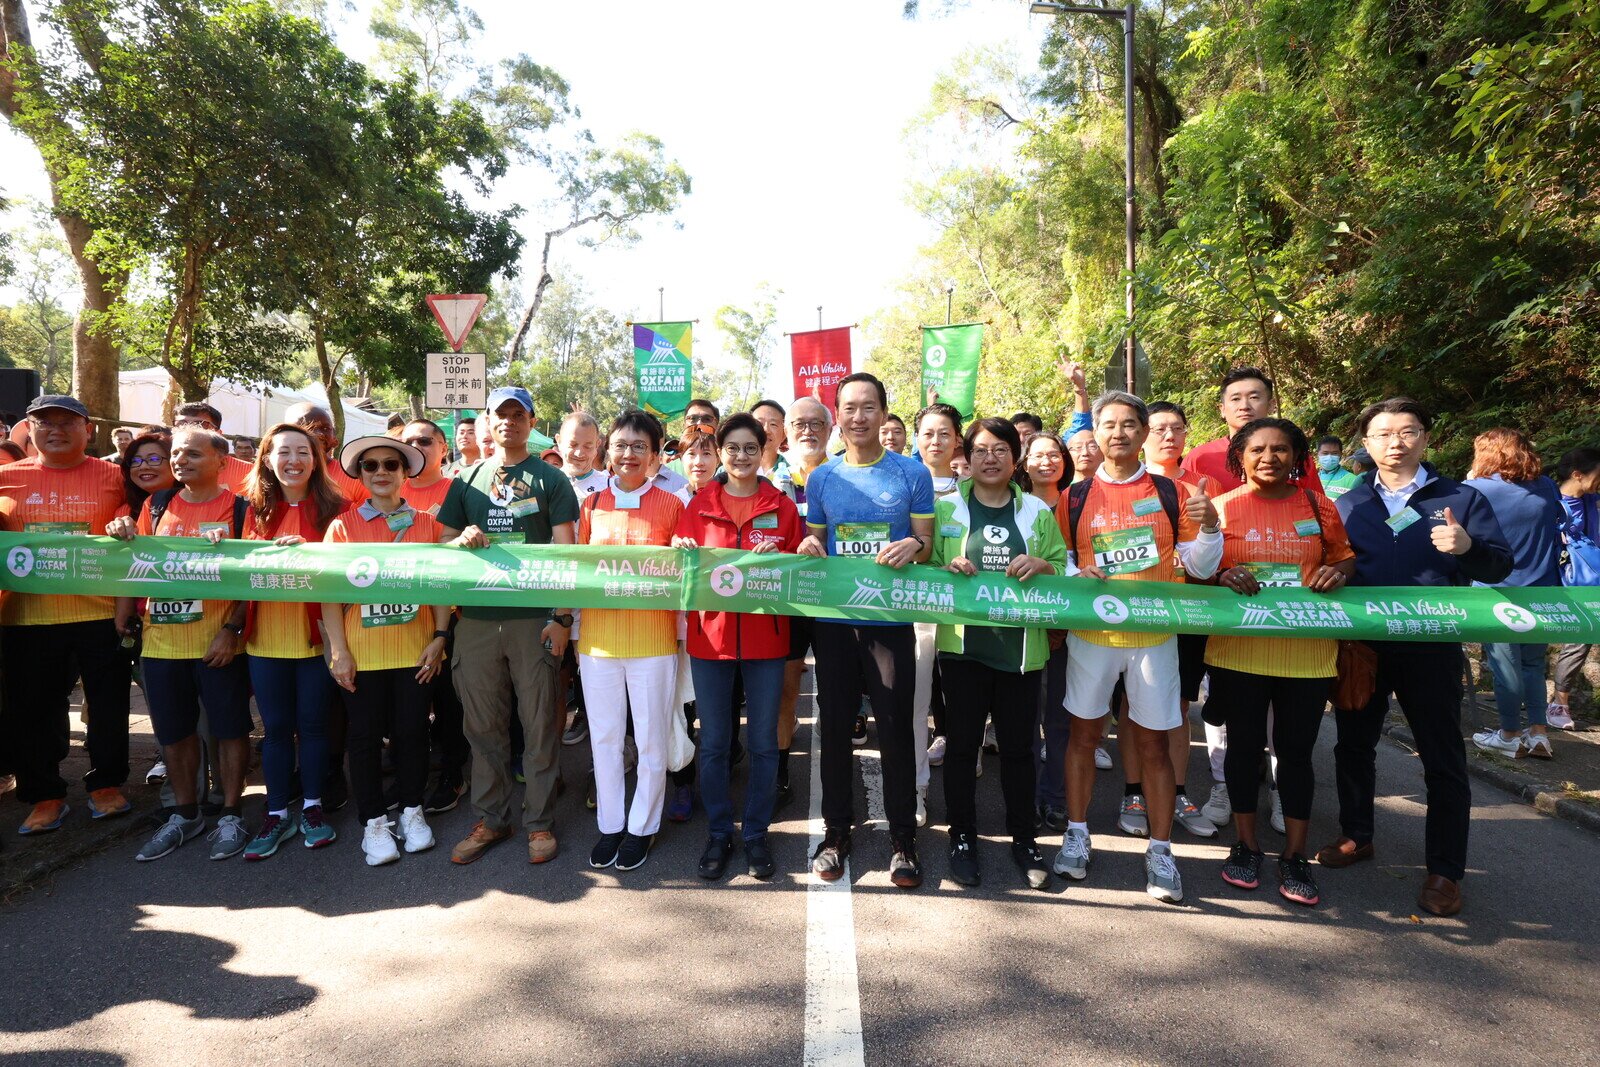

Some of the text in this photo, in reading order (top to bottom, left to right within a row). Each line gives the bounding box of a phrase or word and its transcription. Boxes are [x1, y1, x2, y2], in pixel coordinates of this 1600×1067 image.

[442, 357, 470, 365] STOP
[443, 366, 470, 374] 100m
[798, 362, 847, 376] AIA Vitality
[431, 378, 482, 389] 一百米前
[640, 376, 685, 386] OXFAM
[444, 394, 469, 405] 停車
[487, 518, 514, 526] OXFAM
[842, 541, 881, 554] L001
[983, 545, 1011, 555] 樂施會
[166, 551, 226, 561] 樂施毅行者
[982, 556, 1010, 564] OXFAM
[1102, 546, 1150, 565] L002
[35, 560, 67, 570] OXFAM
[162, 560, 220, 574] OXFAM
[519, 560, 579, 570] 樂施毅行者
[593, 557, 684, 582] AIA Vitality
[35, 571, 65, 580] Hong Kong
[164, 573, 222, 582] TRAILWALKER
[380, 569, 415, 580] OXFAM
[516, 569, 578, 583] OXFAM
[249, 573, 313, 590] 健康程式
[380, 581, 412, 589] Hong Kong
[428, 582, 451, 590] Poverty
[516, 581, 576, 591] TRAILWALKER
[746, 579, 782, 592] OXFAM
[892, 577, 955, 594] 樂施毅行者
[604, 581, 671, 598] 健康程式
[745, 590, 779, 602] Hong Kong
[796, 595, 821, 605] Poverty
[890, 588, 955, 606] OXFAM
[974, 585, 1071, 611] AIA Vitality
[153, 601, 193, 614] L007
[369, 604, 413, 616] L003
[890, 601, 954, 613] TRAILWALKER
[1275, 601, 1343, 610] 樂施毅行者
[1365, 598, 1467, 620] AIA Vitality
[988, 606, 1059, 625] 健康程式
[1131, 607, 1170, 617] OXFAM
[1280, 609, 1351, 621] OXFAM
[1134, 618, 1169, 627] Hong Kong
[1187, 619, 1214, 628] Poverty
[1286, 619, 1354, 628] TRAILWALKER
[1536, 613, 1580, 623] OXFAM
[1386, 619, 1461, 635] 健康程式
[1543, 624, 1580, 633] Hong Kong
